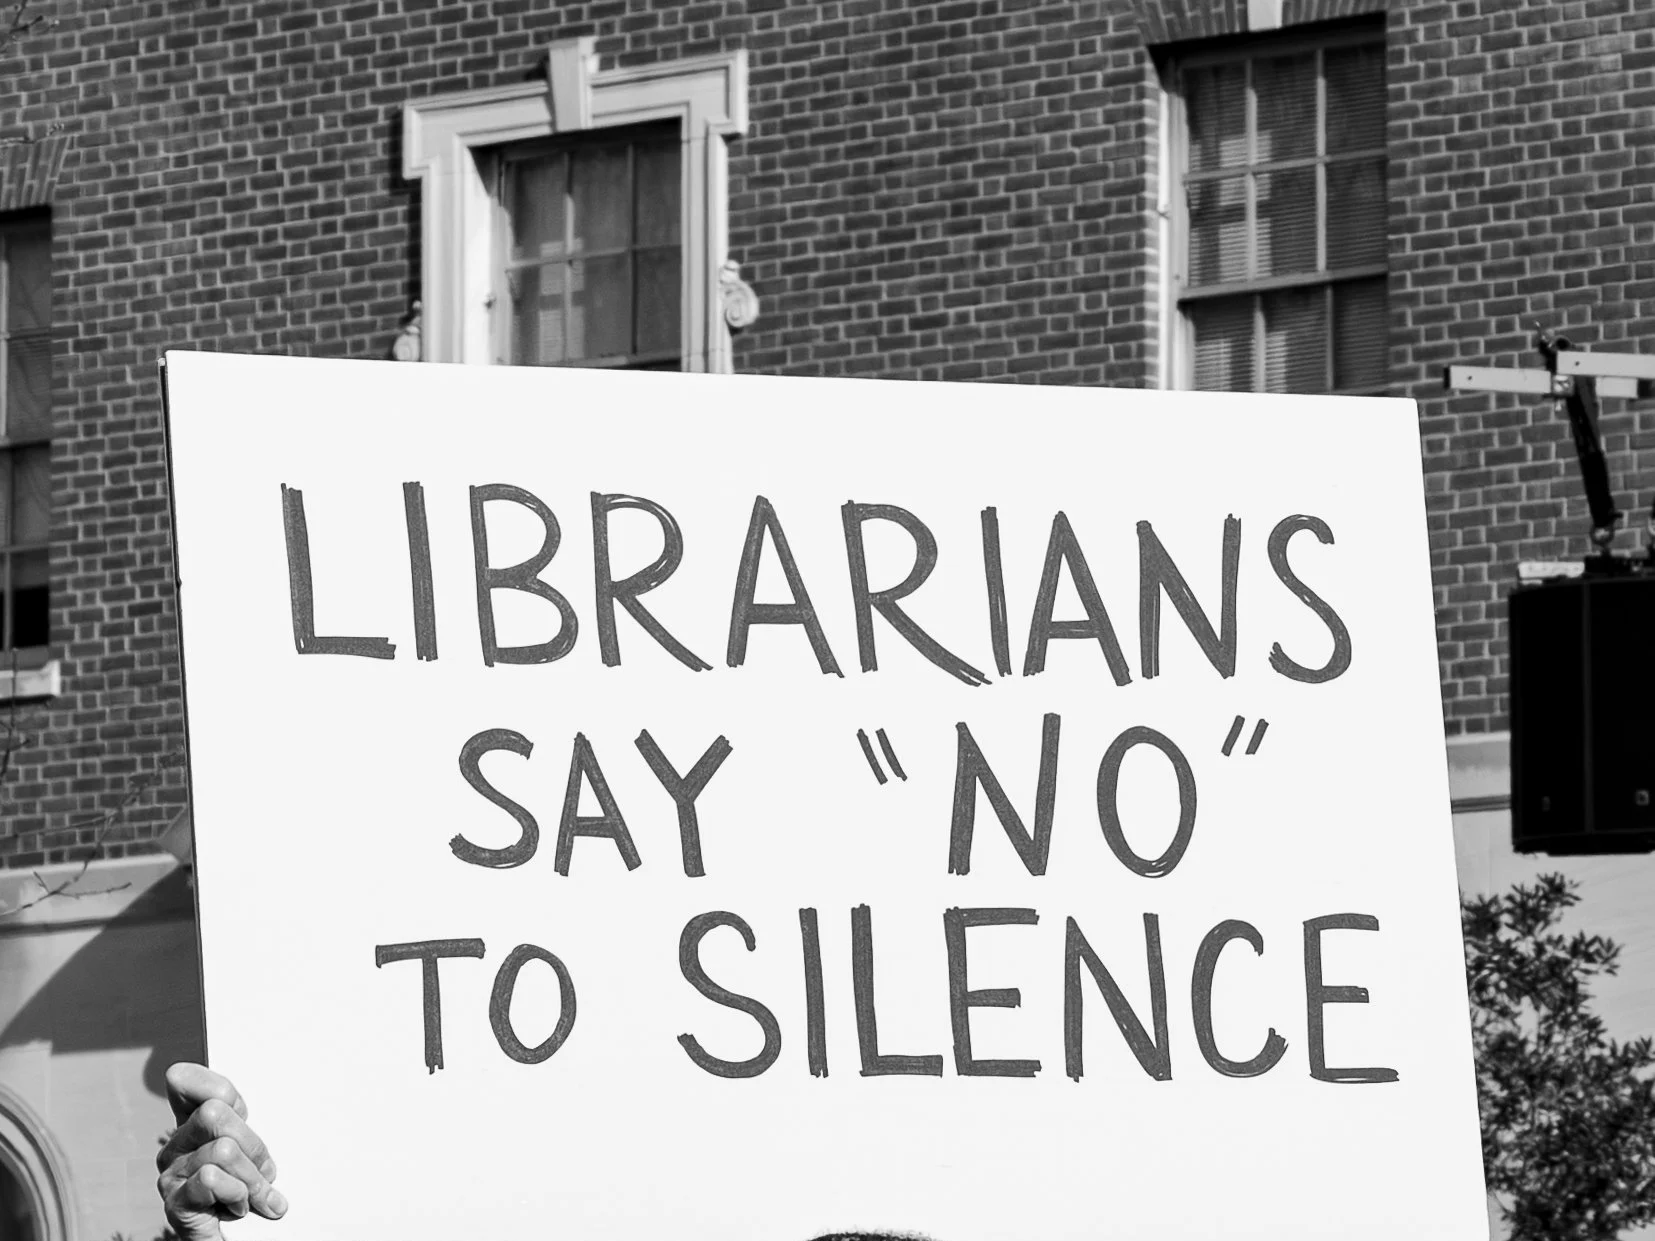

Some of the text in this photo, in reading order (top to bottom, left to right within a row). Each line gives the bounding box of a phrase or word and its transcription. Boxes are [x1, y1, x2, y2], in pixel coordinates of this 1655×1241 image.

[280, 482, 1352, 688] LIBRARIANS
[448, 728, 734, 878] SAY
[374, 906, 1400, 1085] TO SILENCE
